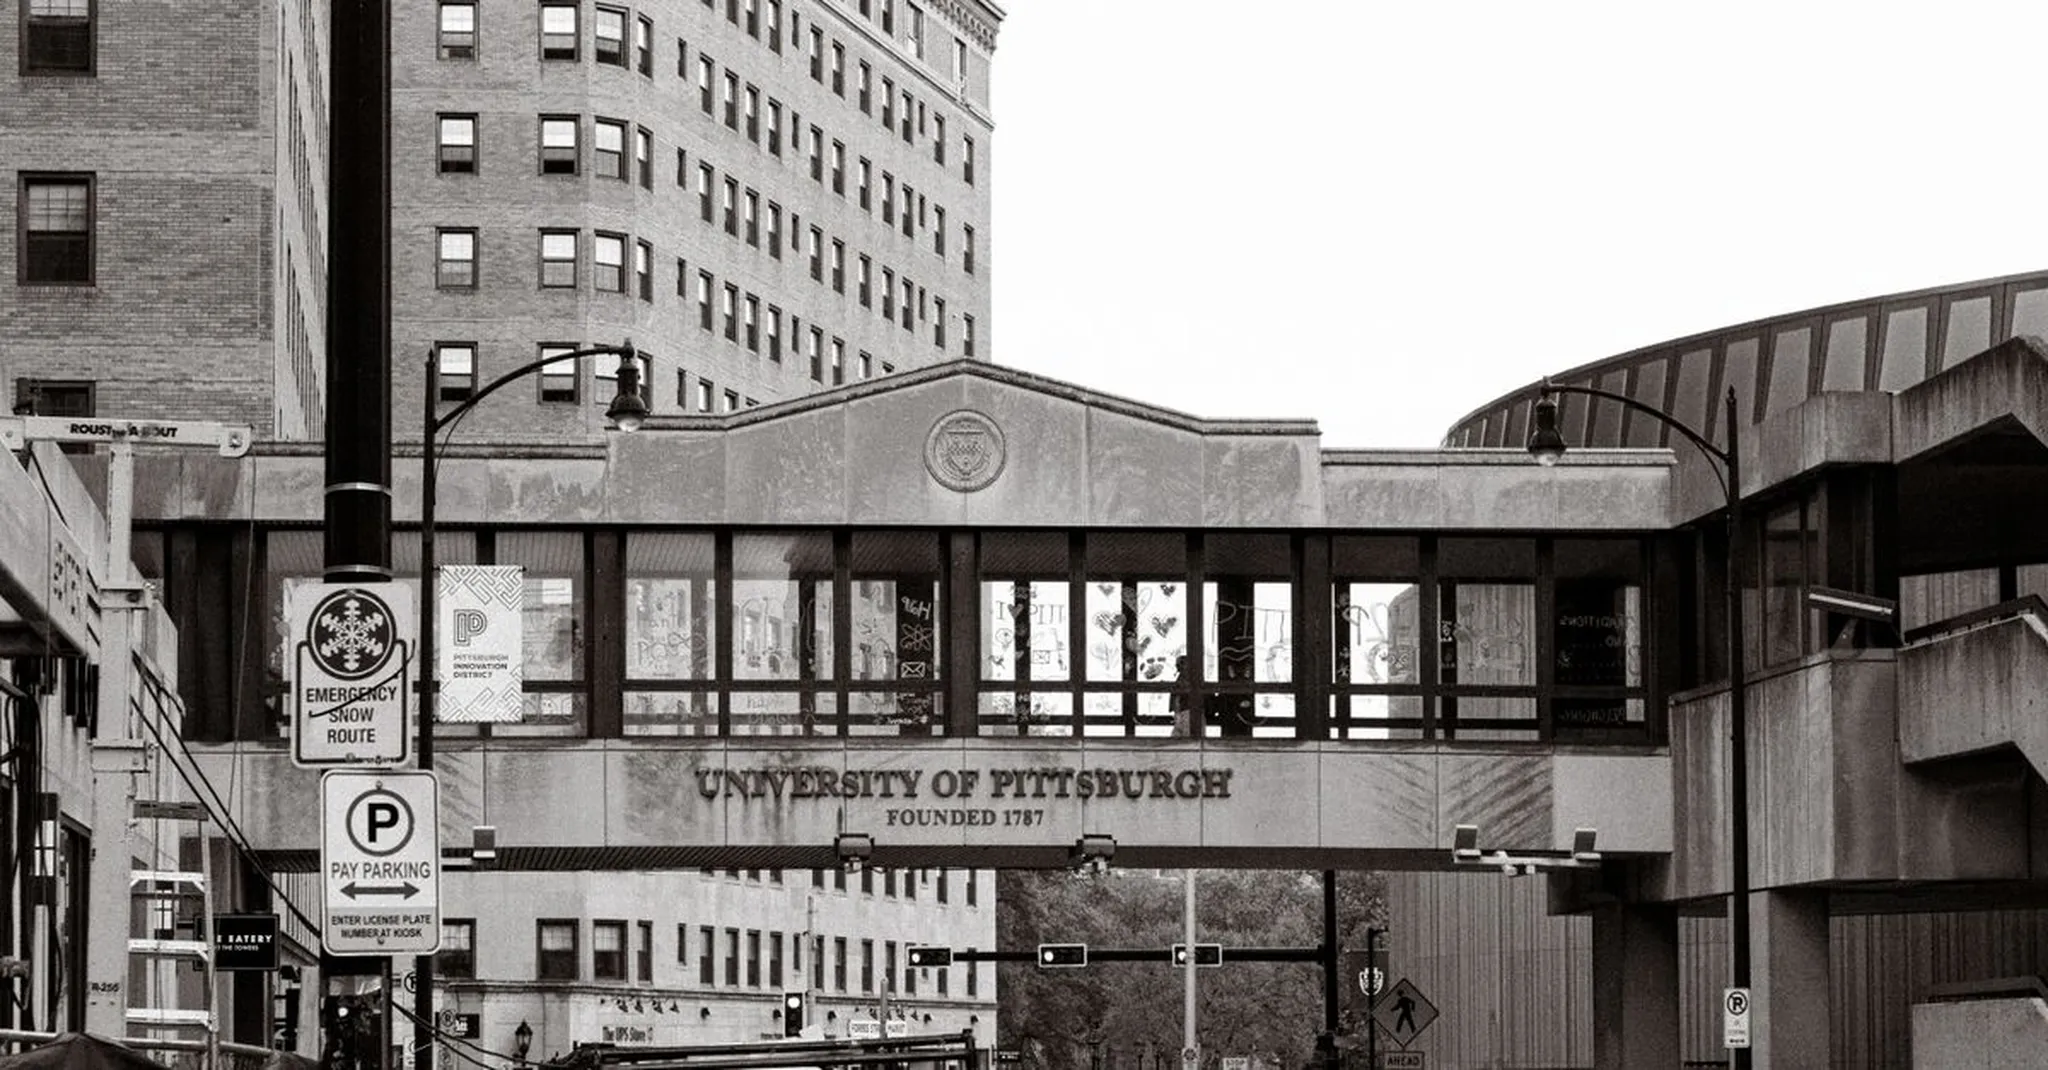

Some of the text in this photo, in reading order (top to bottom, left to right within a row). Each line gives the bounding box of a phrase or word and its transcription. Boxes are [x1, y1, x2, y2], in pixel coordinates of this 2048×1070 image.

[306, 687, 397, 703] EMERGENCY
[329, 708, 374, 723] SNOW
[327, 728, 376, 744] ROUTE
[696, 767, 1234, 800] UNIVERSITY OF PITTSBURGH
[368, 802, 399, 842] P
[887, 809, 1044, 827] FOUNDED 1787
[331, 861, 431, 879] PAY PARKING
[331, 914, 432, 926] ENTER LICENSE PLATE
[228, 934, 273, 943] EATERY
[341, 928, 423, 938] NUMBER AT KIOSK
[602, 1025, 614, 1042] The
[615, 1026, 629, 1042] UPS
[630, 1026, 646, 1043] Store
[1387, 1055, 1421, 1066] AHEAD
